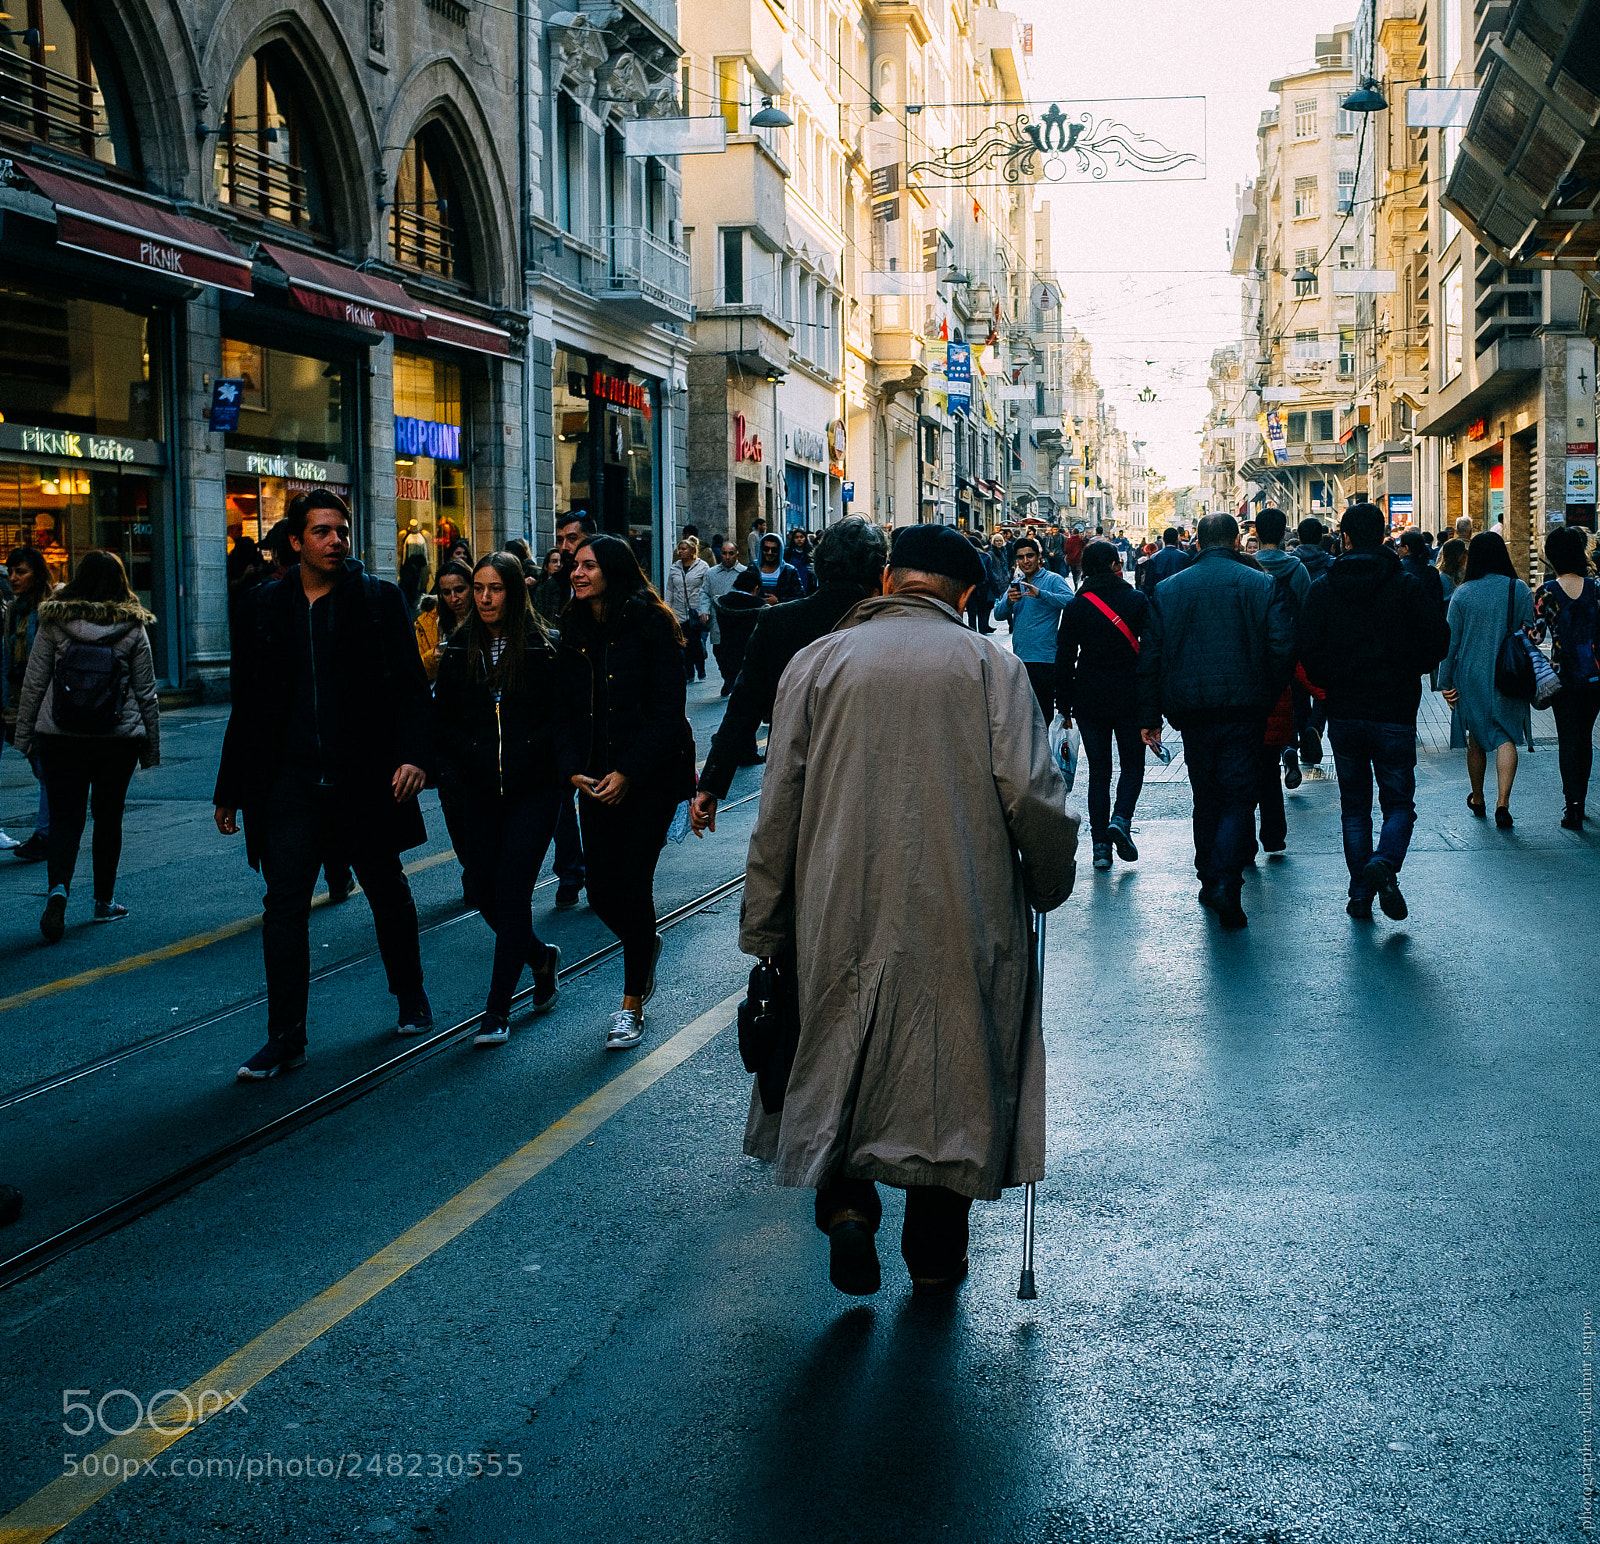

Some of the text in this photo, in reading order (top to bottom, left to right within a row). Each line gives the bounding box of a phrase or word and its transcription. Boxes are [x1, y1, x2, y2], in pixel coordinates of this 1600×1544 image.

[23, 427, 135, 462] PİKNİK köfte
[247, 452, 327, 481] PİKNİK köfte
